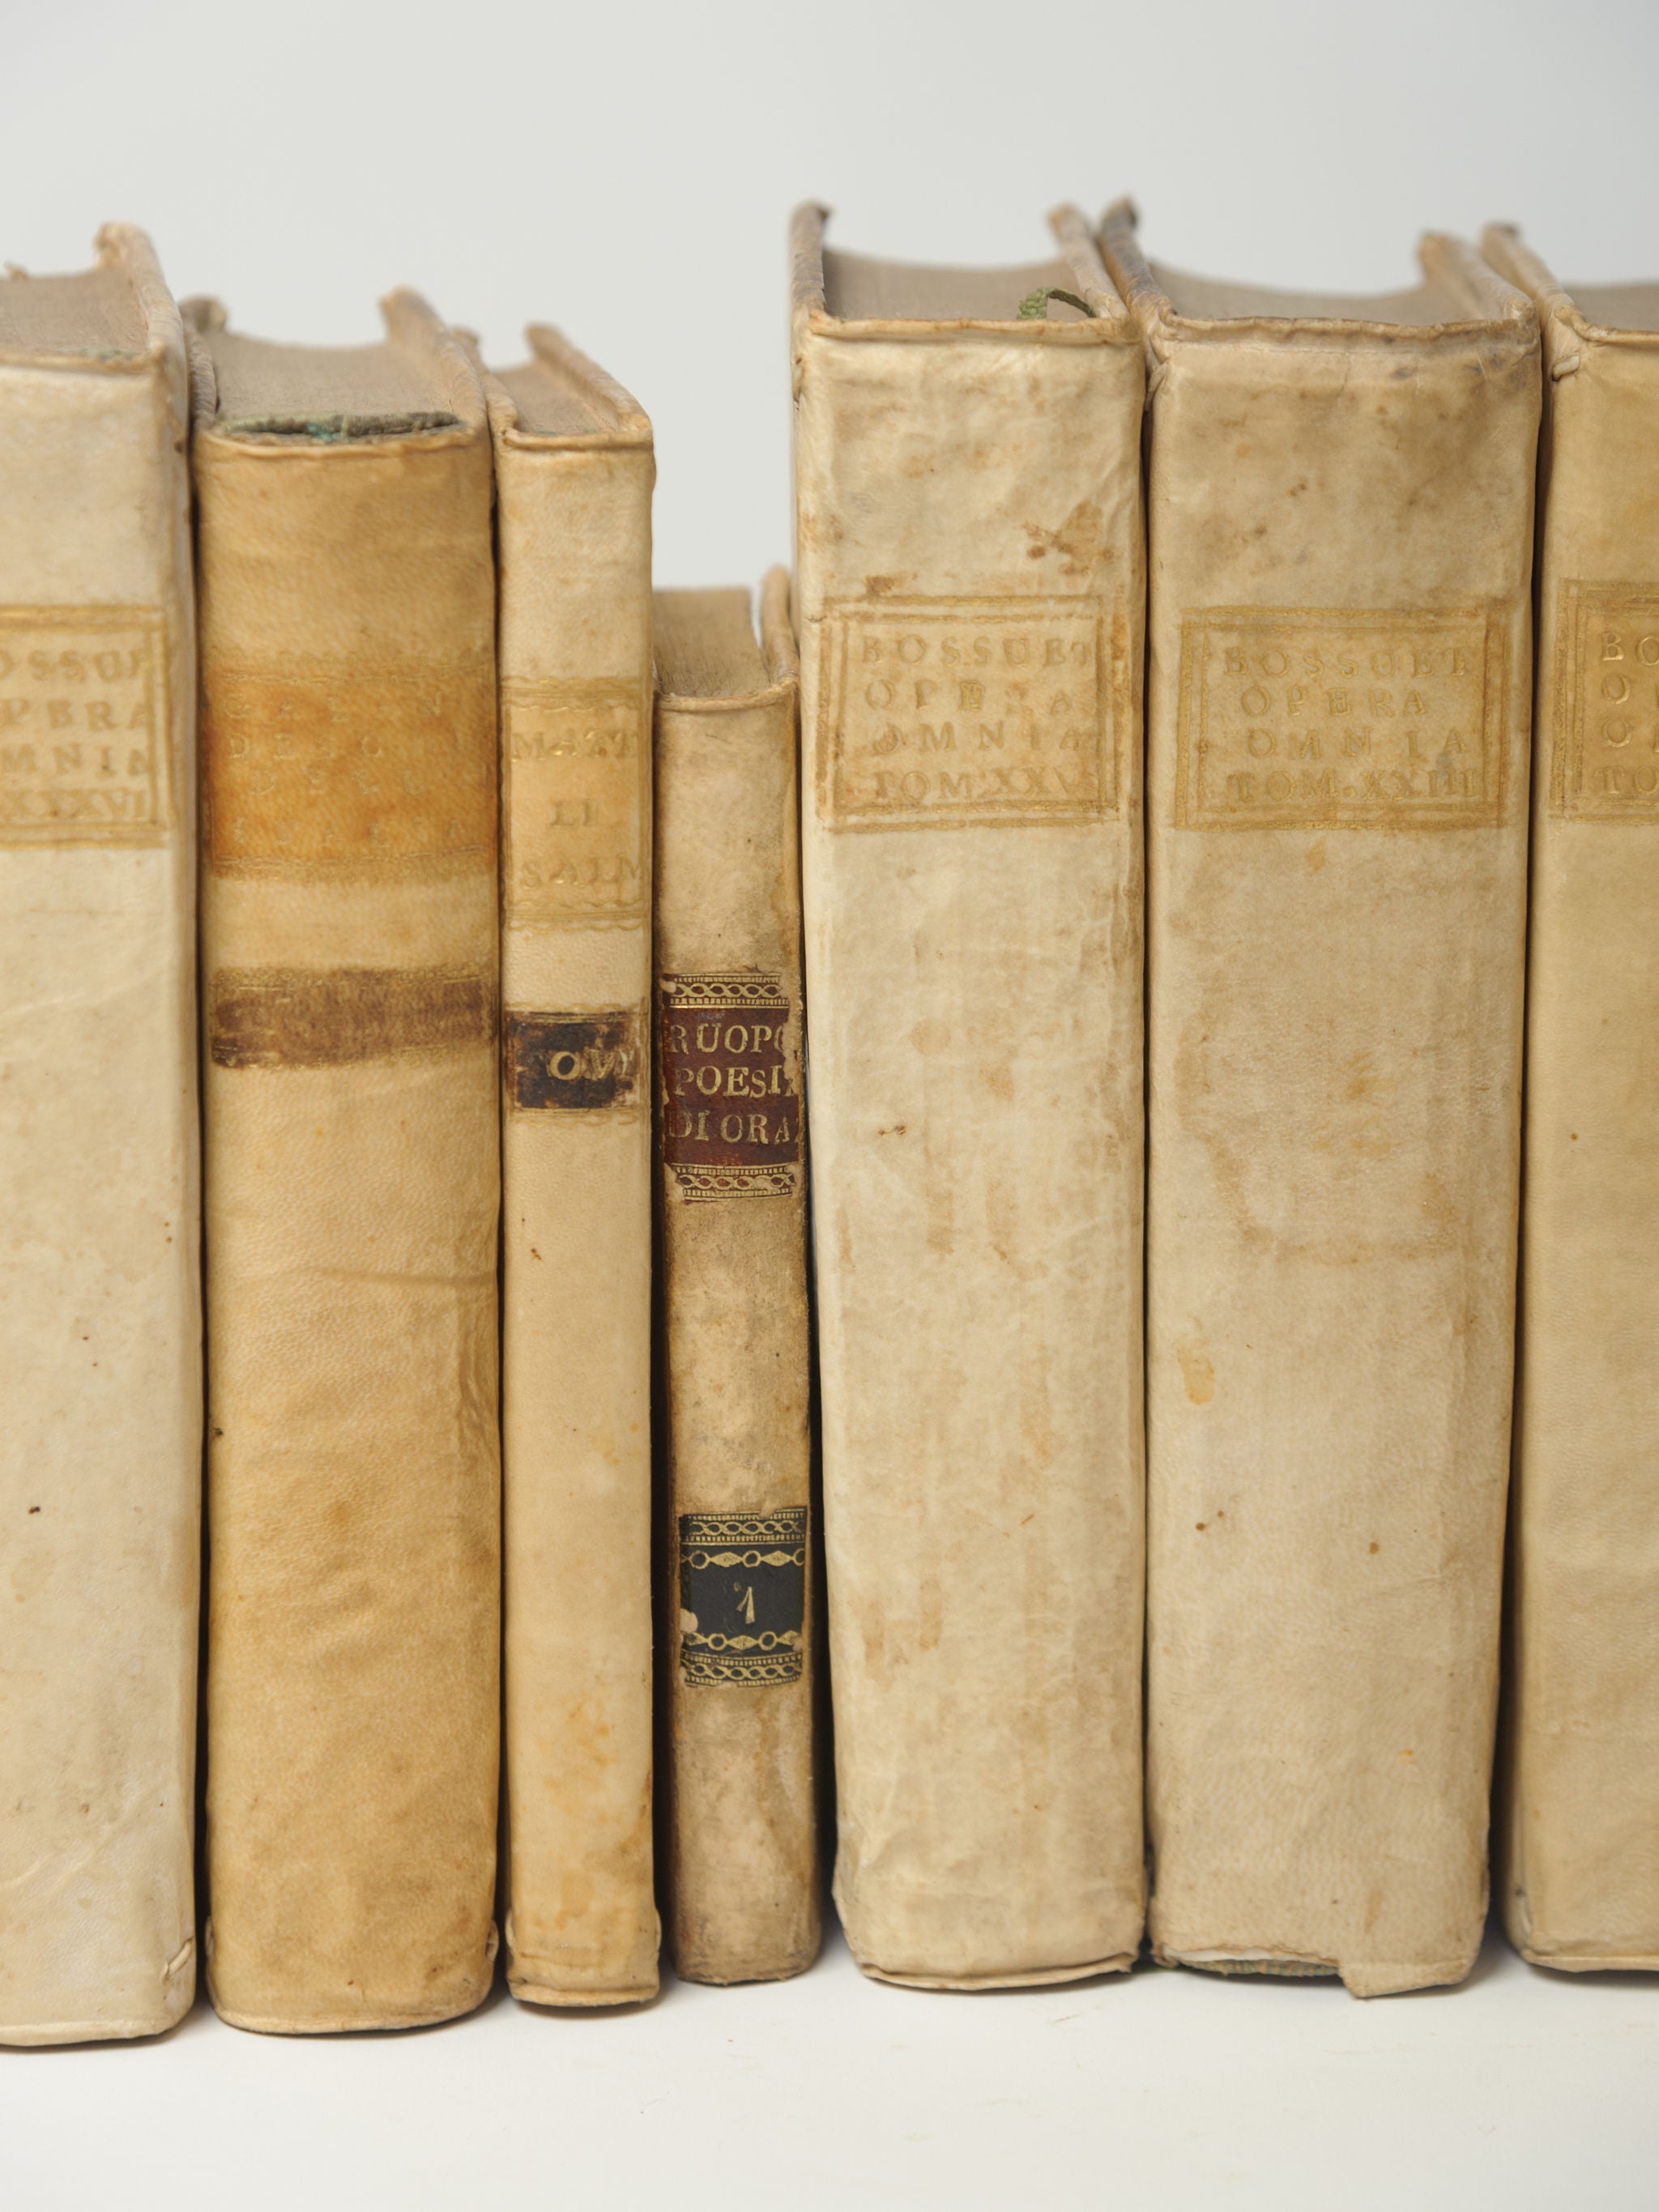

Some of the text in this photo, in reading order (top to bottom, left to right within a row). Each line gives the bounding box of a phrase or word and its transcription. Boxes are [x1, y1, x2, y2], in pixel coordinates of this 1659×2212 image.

[1223, 646, 1468, 680] BOSSUET
[1241, 684, 1427, 718] OPERA
[1247, 728, 1468, 761] OMNIA
[674, 1065, 794, 1098] POESI
[720, 1115, 799, 1145] ORA
[736, 1586, 755, 1624] 1
